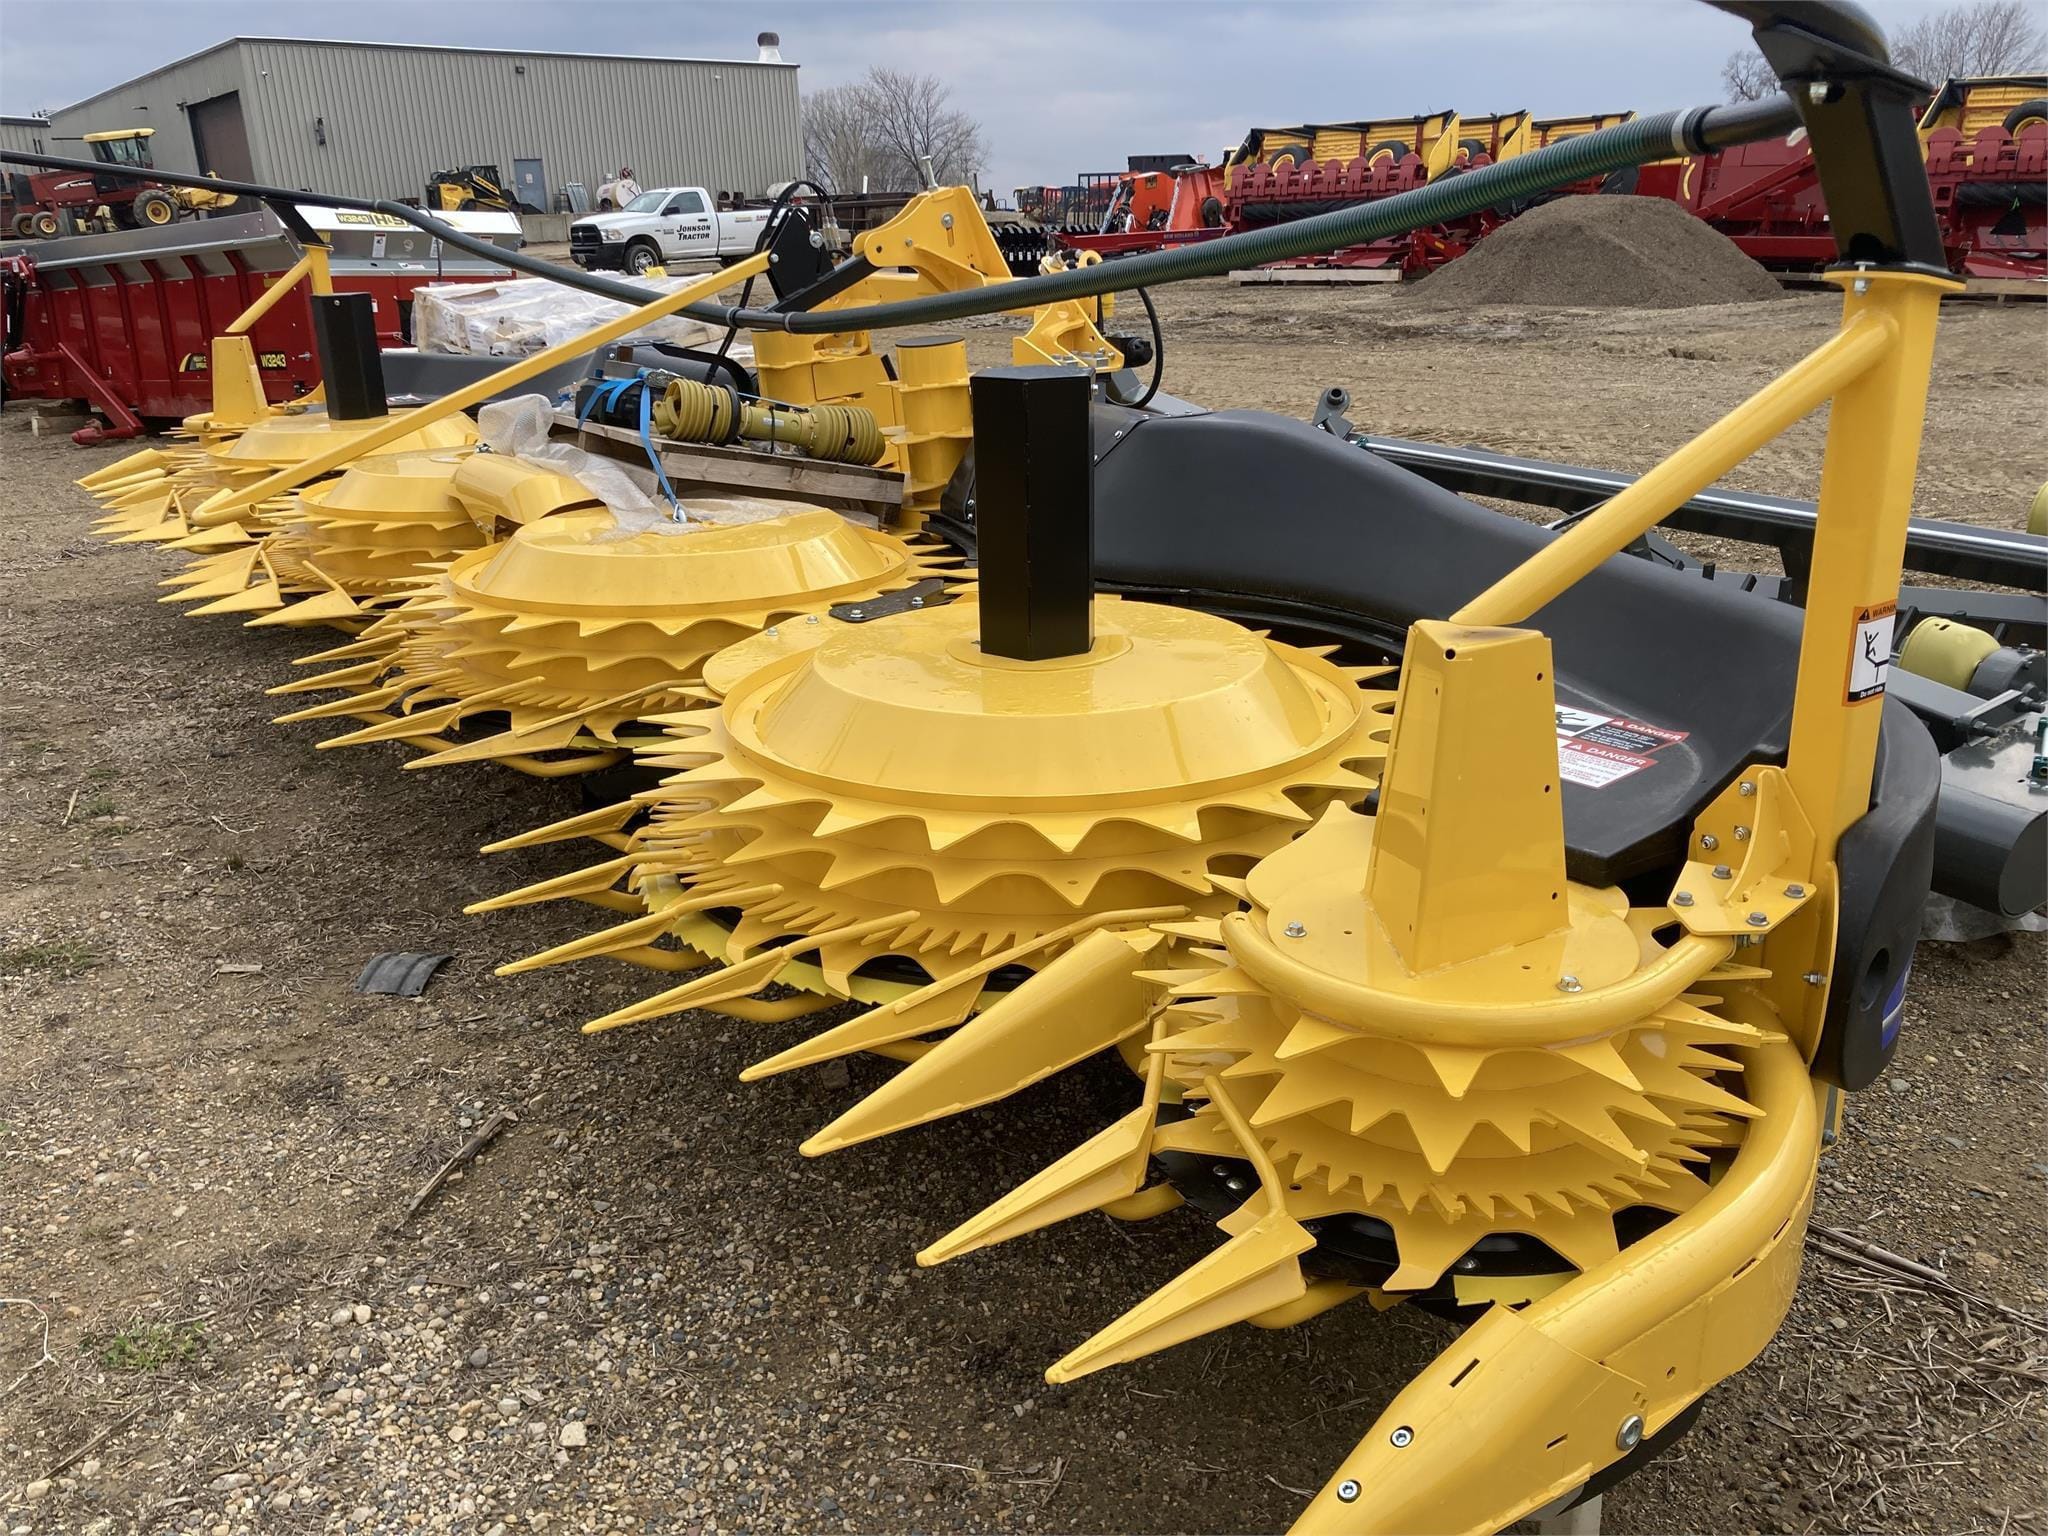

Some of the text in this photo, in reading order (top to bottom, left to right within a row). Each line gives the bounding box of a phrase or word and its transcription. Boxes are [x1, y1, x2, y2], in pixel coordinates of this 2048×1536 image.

[677, 224, 711, 233] JOHNSON
[678, 232, 710, 241] TRACTOR
[260, 354, 287, 368] W3243
[1872, 603, 1896, 617] WARNIN
[1626, 723, 1682, 741] DANGER
[1586, 747, 1647, 766] DANGER
